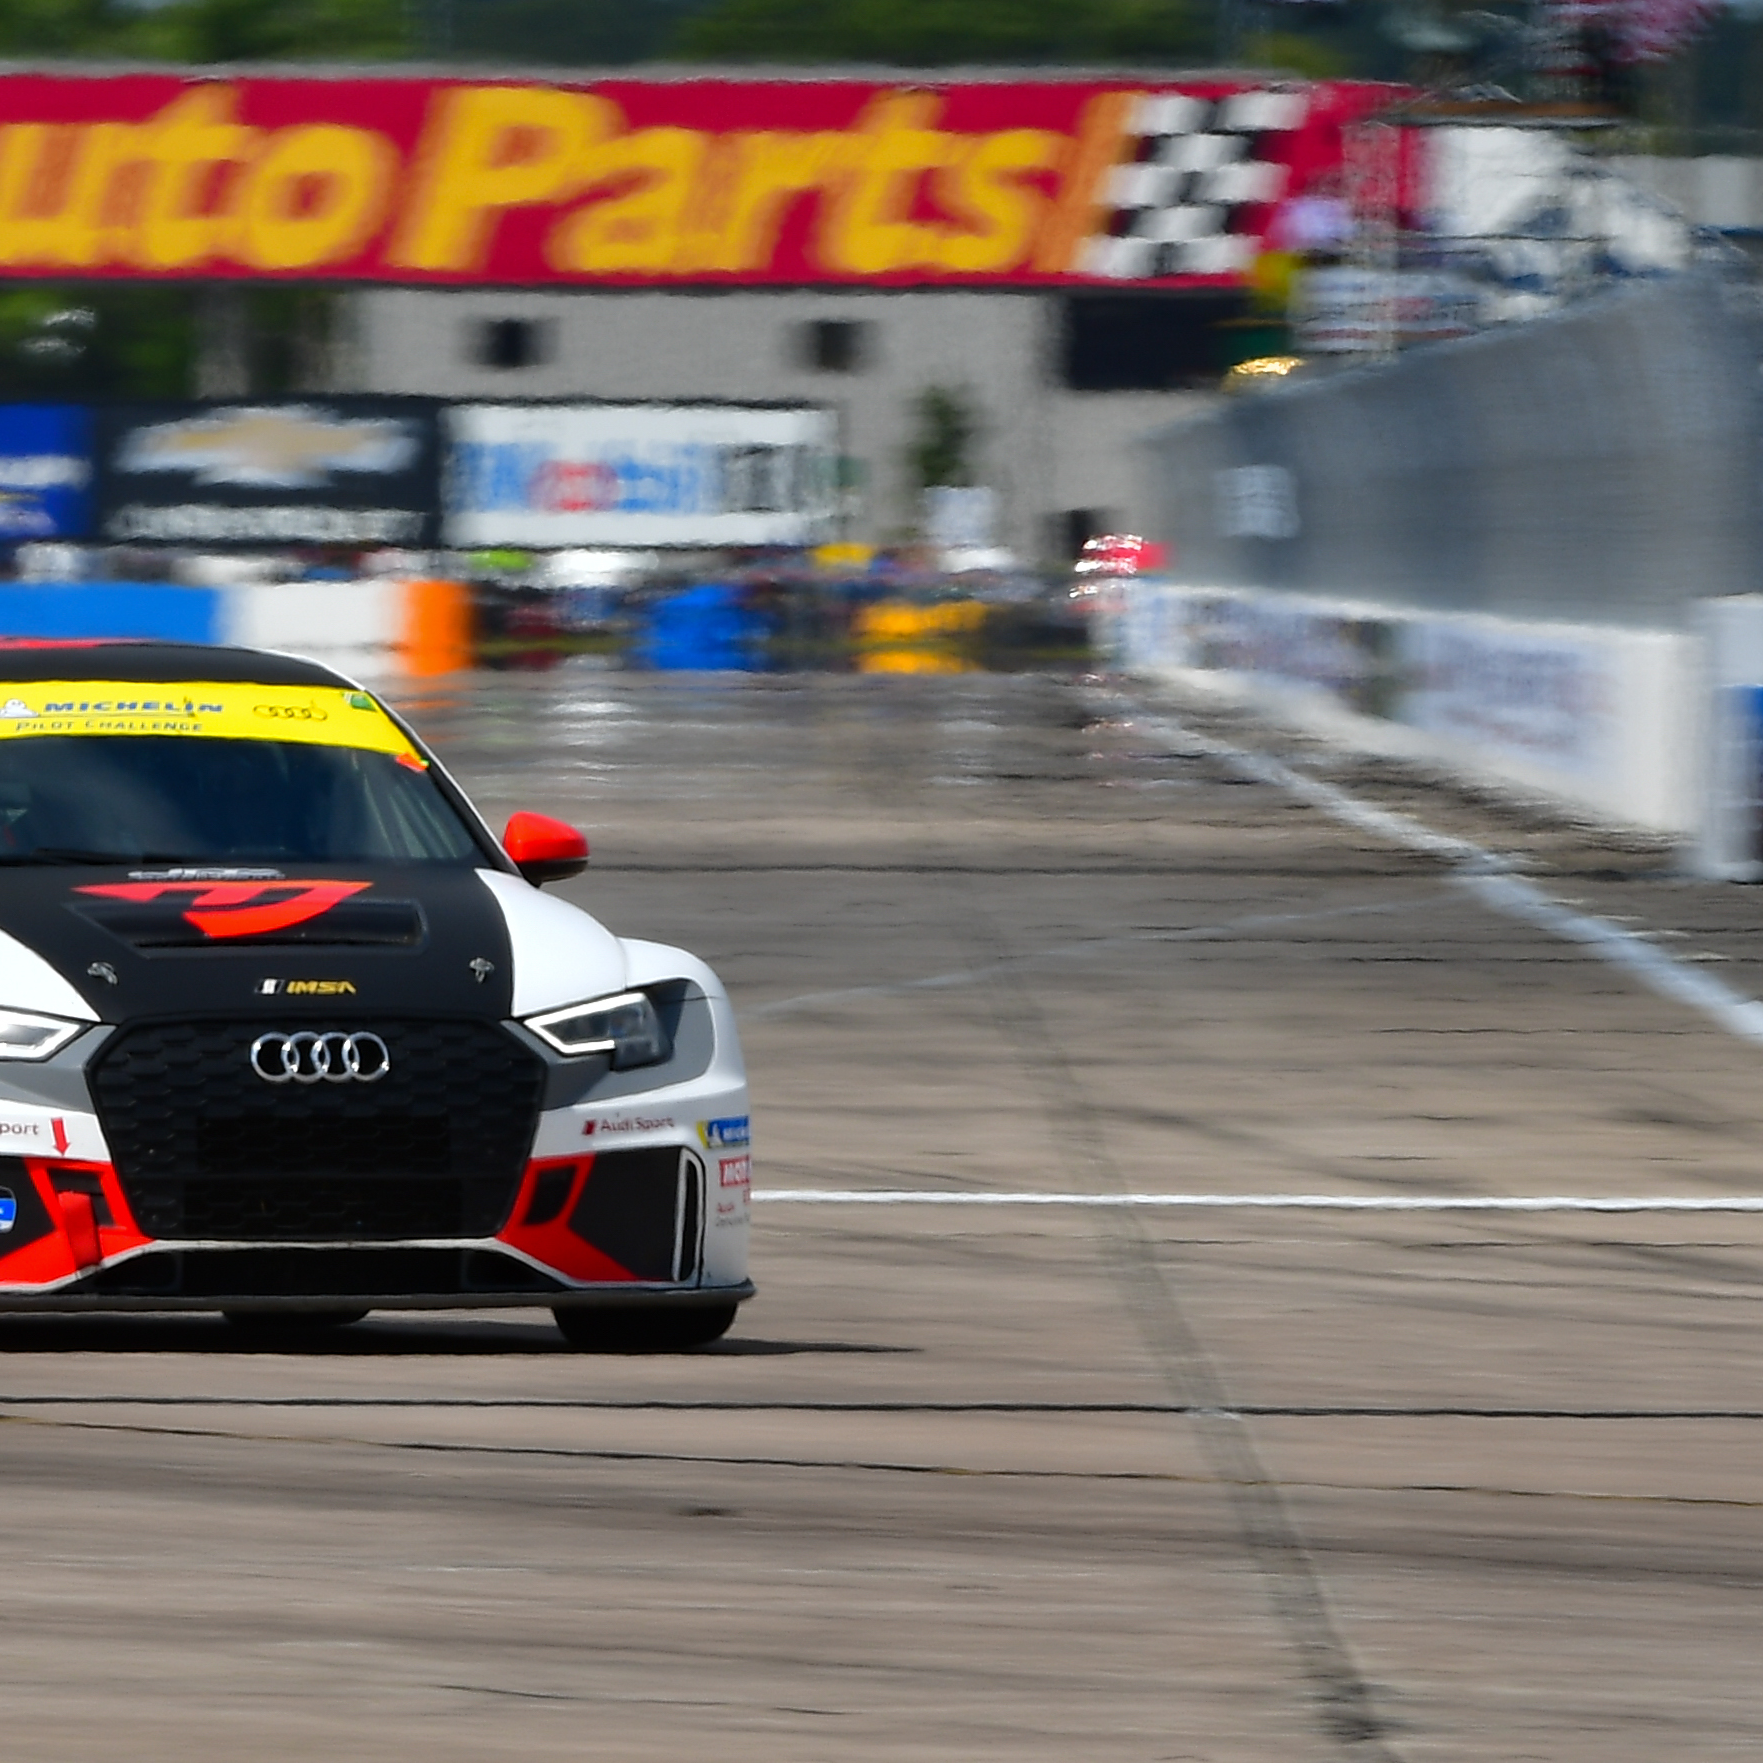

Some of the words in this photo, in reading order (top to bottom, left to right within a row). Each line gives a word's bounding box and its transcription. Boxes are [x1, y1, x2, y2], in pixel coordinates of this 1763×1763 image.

[385, 86, 1063, 274] Parts
[44, 702, 224, 713] MICHELIN
[15, 721, 75, 731] PILOT
[84, 719, 203, 732] CHALLENGE
[286, 980, 356, 995] IMSA
[601, 1118, 633, 1132] Audi
[636, 1116, 675, 1131] Sport
